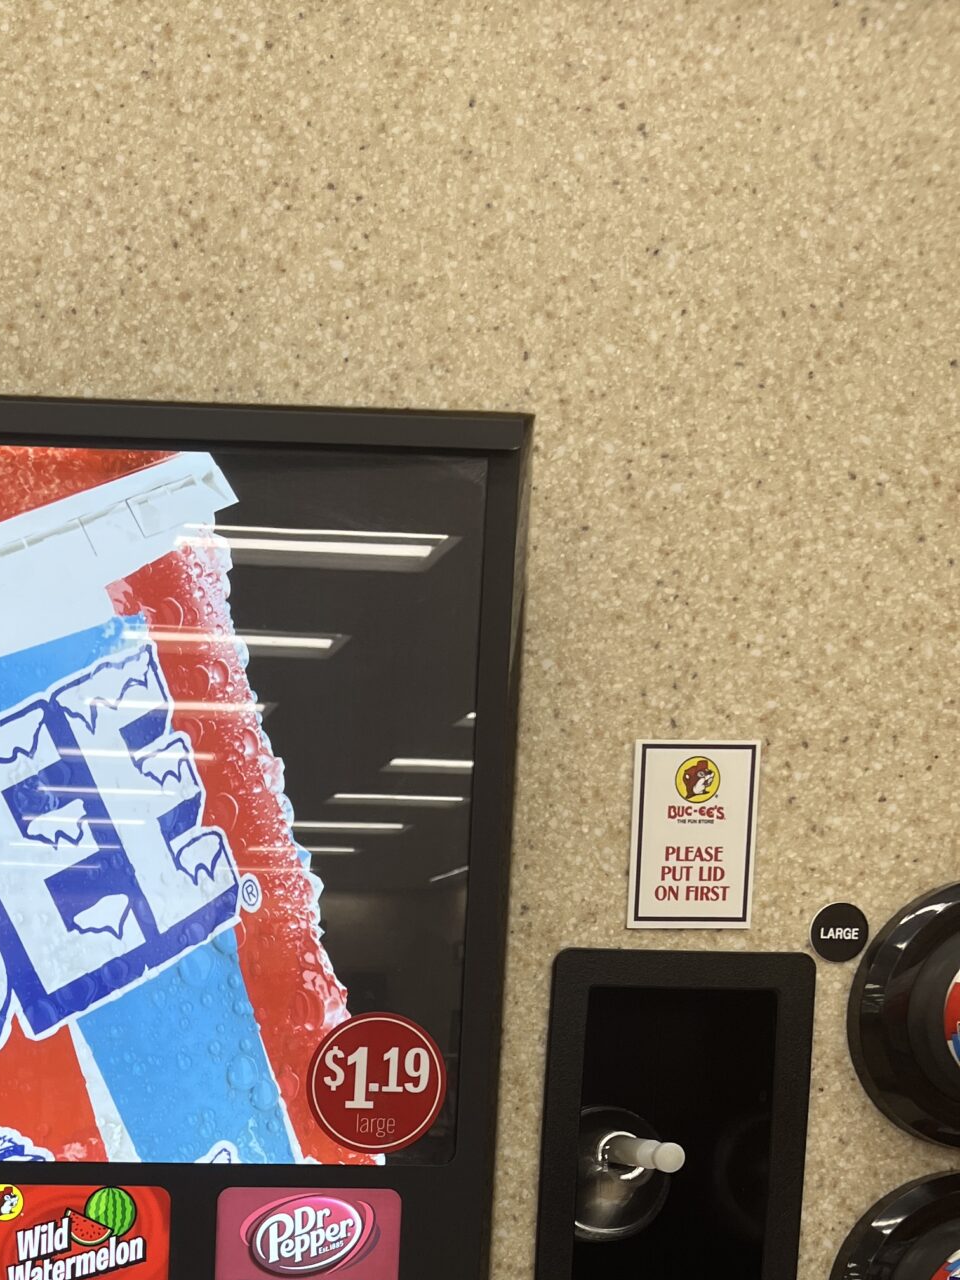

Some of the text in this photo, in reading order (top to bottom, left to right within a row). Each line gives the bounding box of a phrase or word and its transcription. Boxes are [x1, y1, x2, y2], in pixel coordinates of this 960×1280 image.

[665, 846, 723, 862] PLEASE
[661, 866, 725, 881] PUT LID
[654, 886, 730, 901] ON FIRST
[820, 927, 859, 940] LARGE
[323, 1046, 430, 1109] $1.19
[356, 1113, 396, 1138] large
[294, 1206, 331, 1236] Dr
[16, 1217, 73, 1262] Wild
[256, 1213, 354, 1263] Pepper
